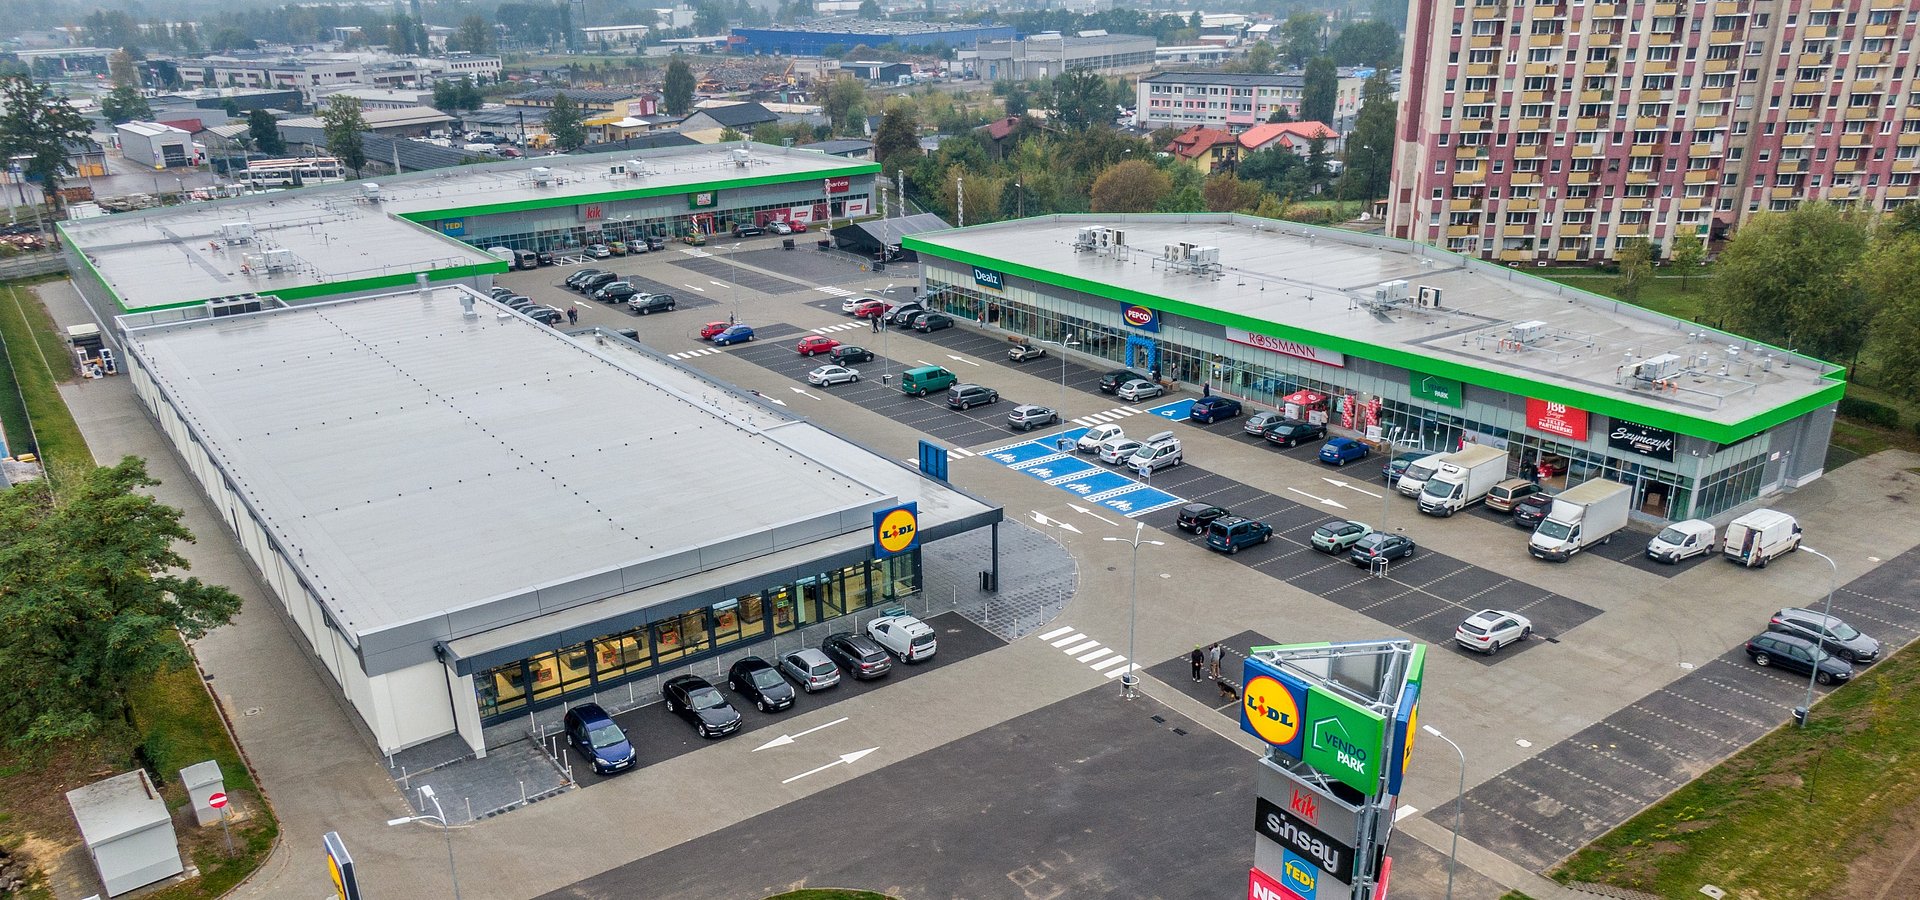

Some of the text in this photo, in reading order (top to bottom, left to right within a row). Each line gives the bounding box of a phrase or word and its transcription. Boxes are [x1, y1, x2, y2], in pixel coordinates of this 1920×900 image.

[974, 268, 999, 285] Dealz
[1127, 310, 1149, 321] PEPCO
[1248, 332, 1316, 358] ROSSMANN
[1434, 390, 1449, 399] PARK
[1546, 401, 1566, 414] JBB
[1610, 427, 1671, 451] Szymczyk
[1324, 731, 1367, 761] VENDO
[1336, 750, 1366, 775] PARK
[1266, 813, 1339, 873] sinsay
